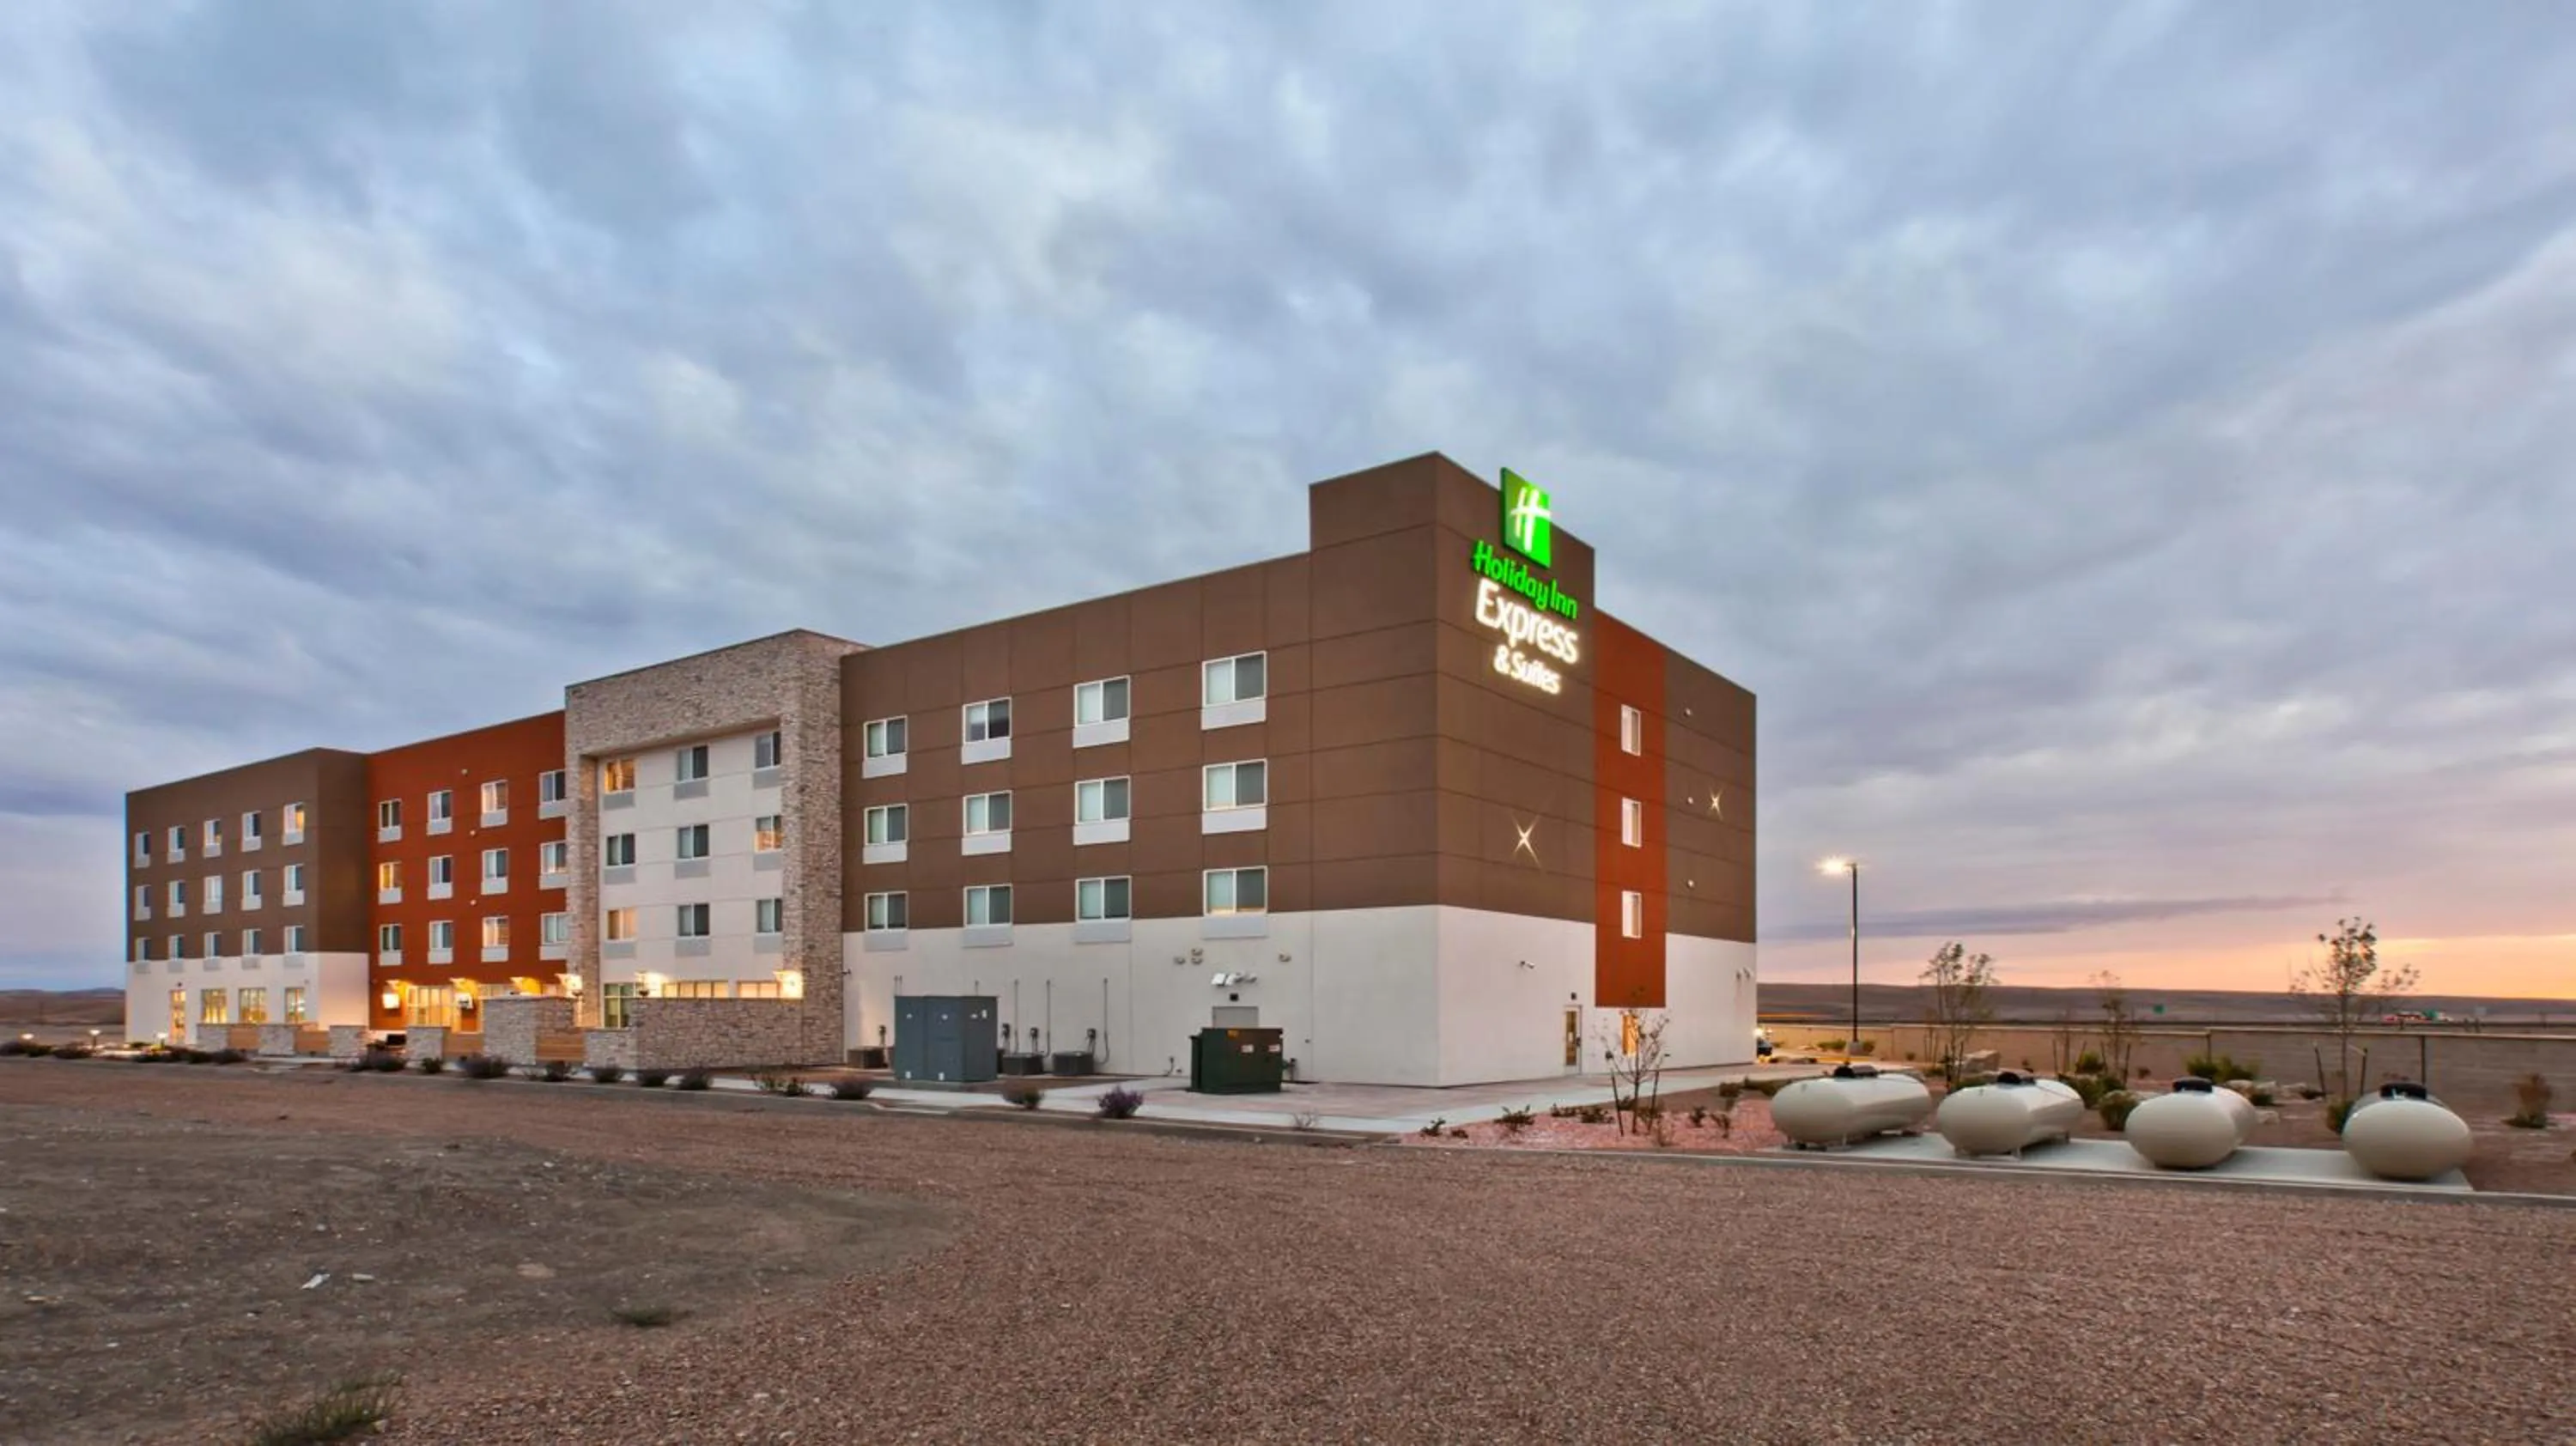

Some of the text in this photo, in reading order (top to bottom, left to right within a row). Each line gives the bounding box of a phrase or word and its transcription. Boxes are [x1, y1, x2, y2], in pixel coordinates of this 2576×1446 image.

[1473, 540, 1578, 619] Holiday Inn
[1475, 577, 1579, 665] Express
[1493, 645, 1562, 695] & Suites
